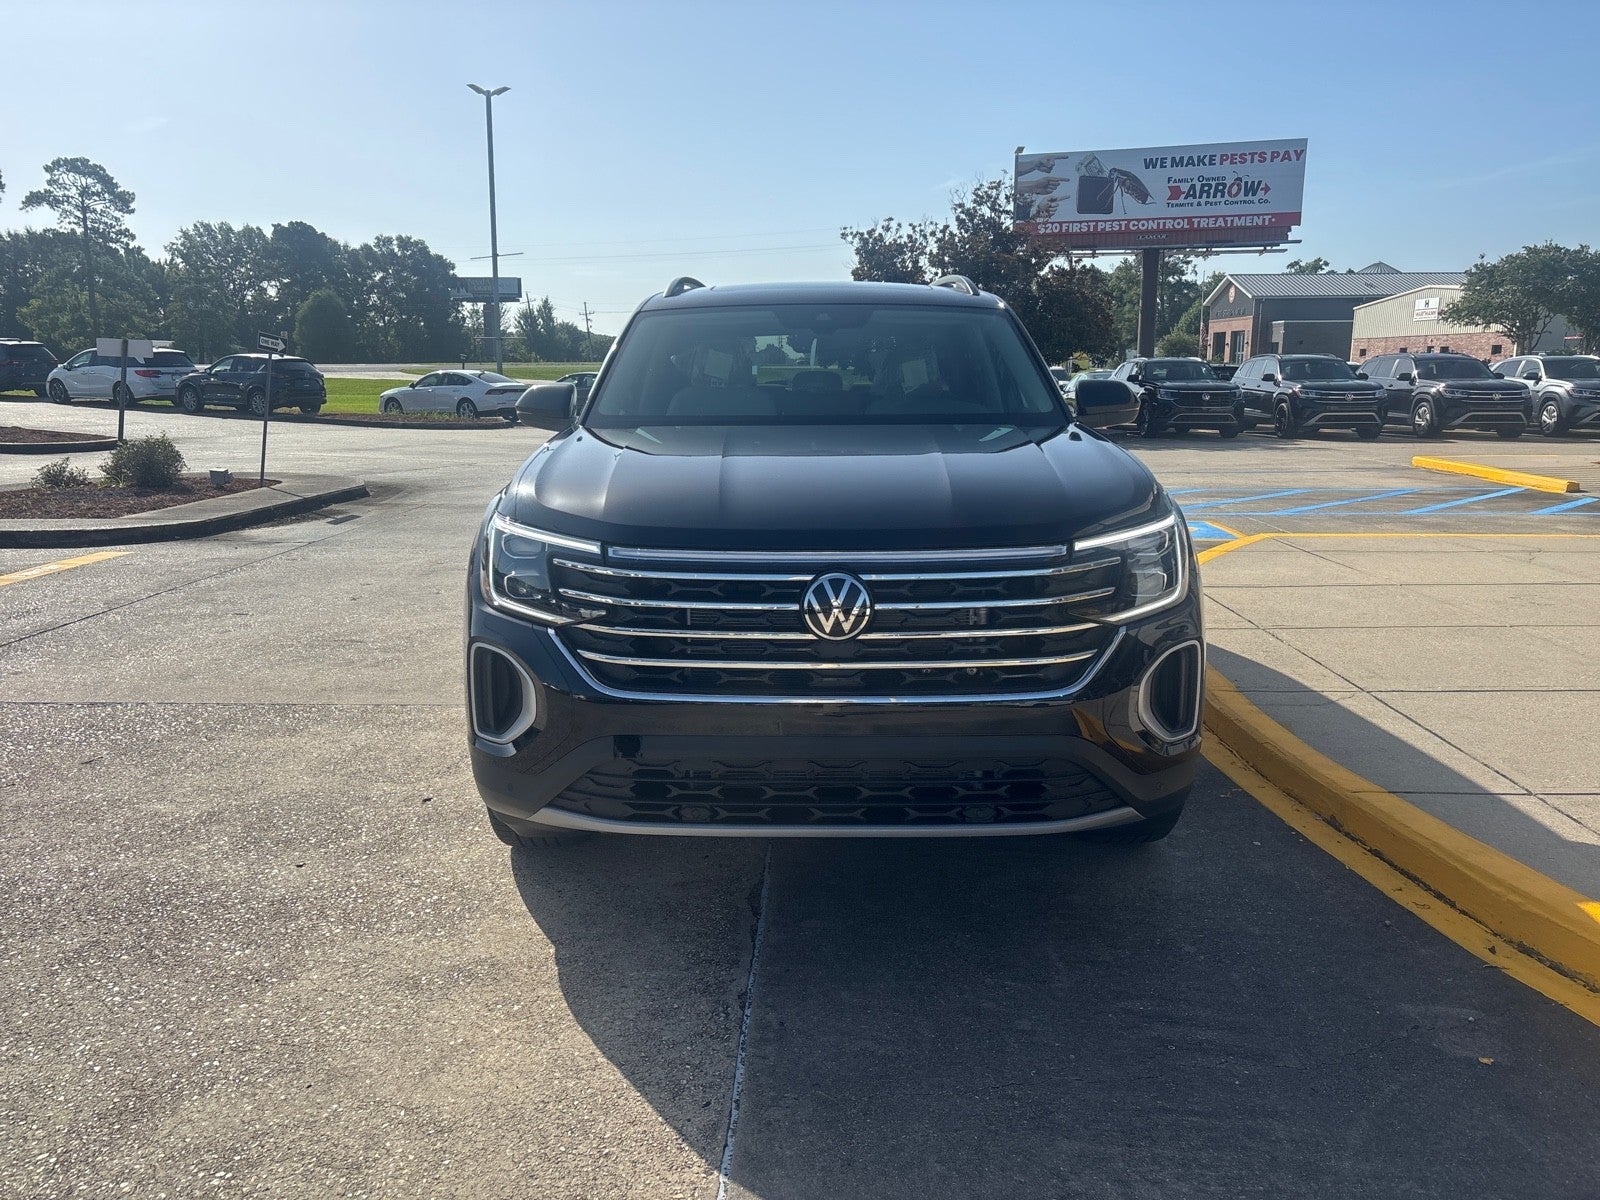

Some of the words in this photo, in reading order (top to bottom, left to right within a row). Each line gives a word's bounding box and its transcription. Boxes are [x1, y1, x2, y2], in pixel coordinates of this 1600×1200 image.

[1143, 157, 1168, 170] WE
[1170, 154, 1217, 168] MAKE
[1219, 151, 1267, 166] PESTS
[1270, 149, 1305, 163] PAY
[1167, 176, 1195, 184] FAMILY
[1197, 175, 1227, 183] OWNED
[1184, 181, 1262, 200] ARROW
[1037, 223, 1060, 234] $20
[1061, 222, 1096, 233] FIRST
[1097, 220, 1128, 232] PEST
[1129, 218, 1190, 230] CONTROL
